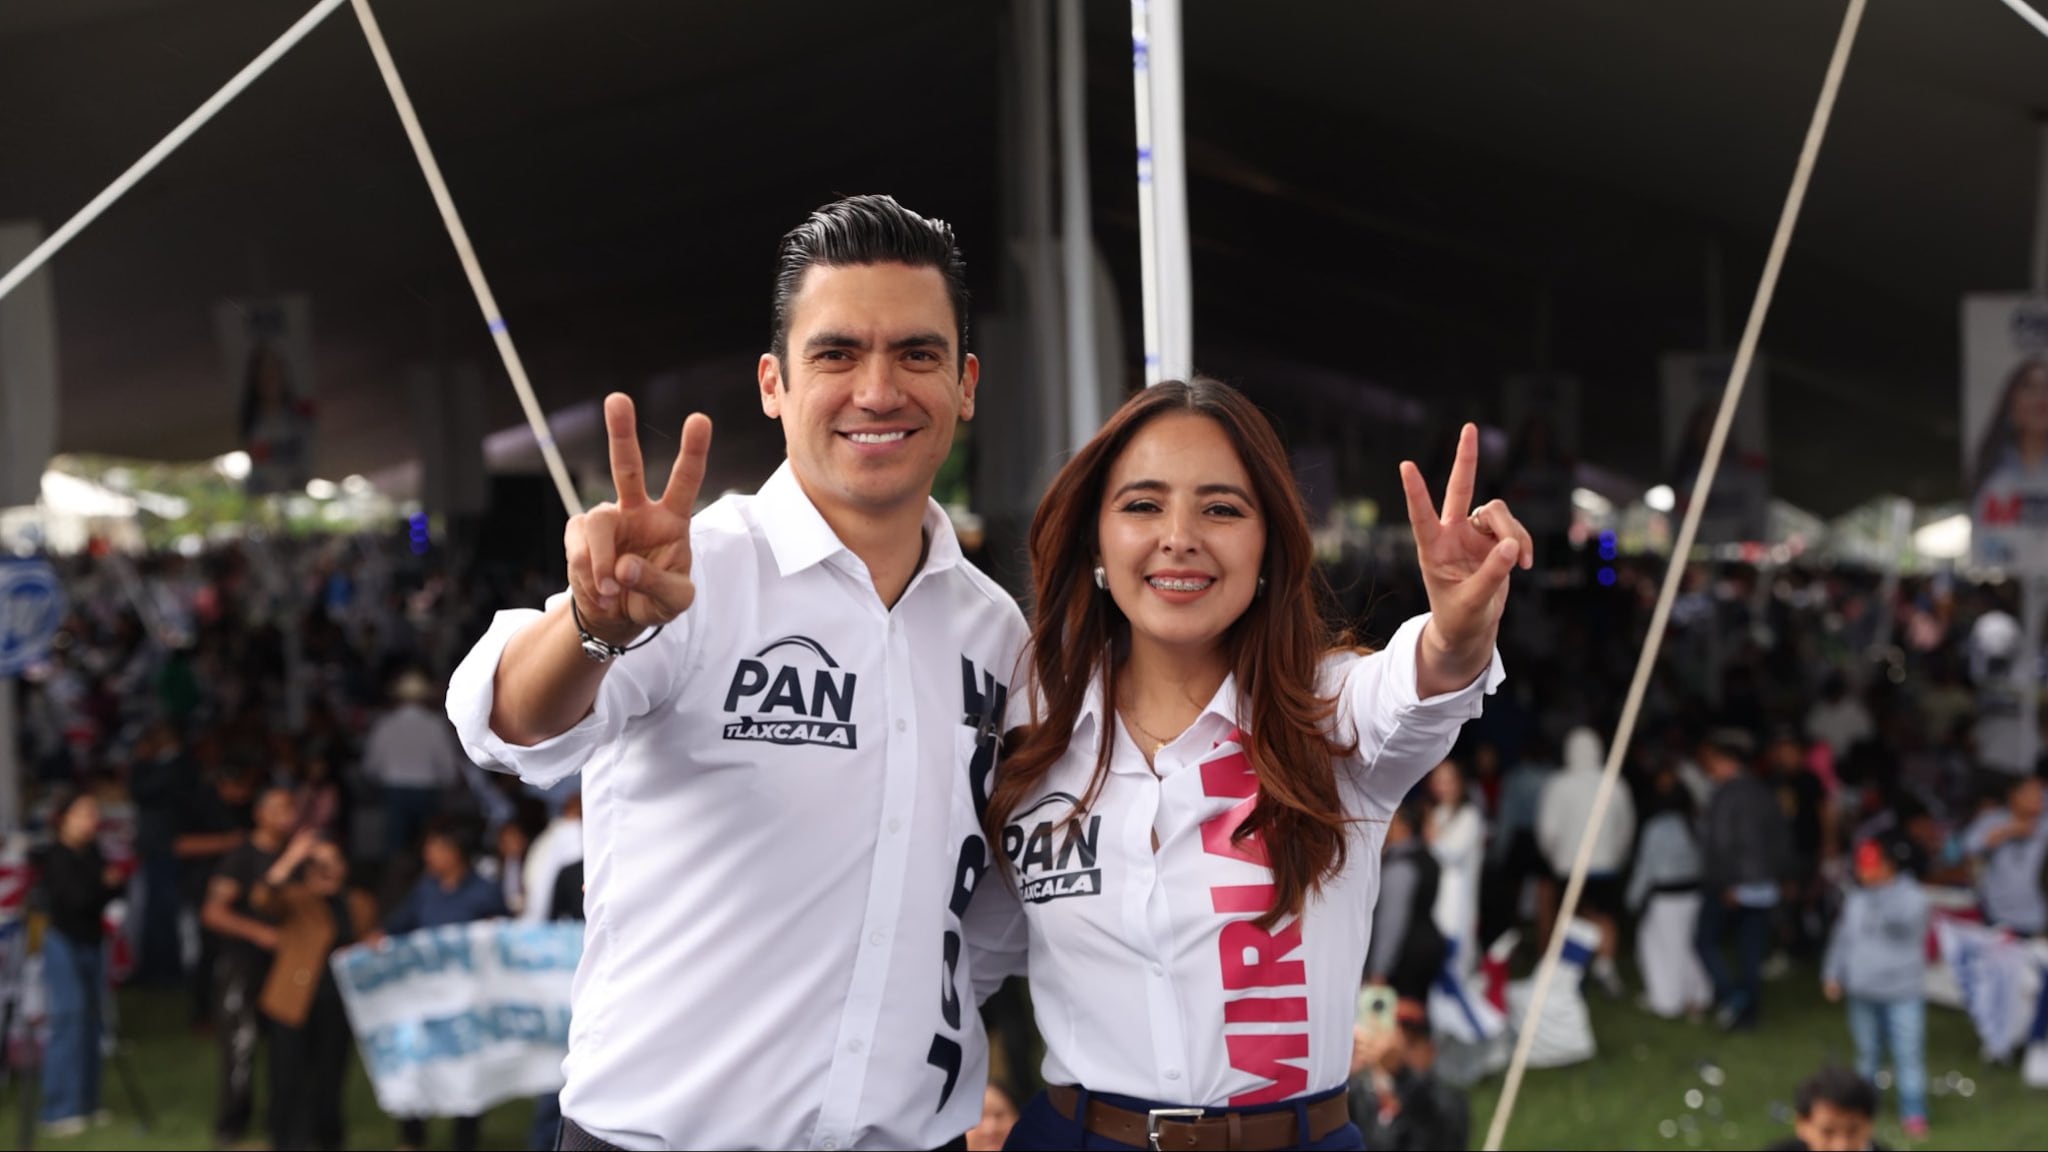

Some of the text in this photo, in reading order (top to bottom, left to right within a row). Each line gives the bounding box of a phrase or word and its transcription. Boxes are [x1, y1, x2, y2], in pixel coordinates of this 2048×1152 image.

[723, 658, 857, 723] PAN
[726, 722, 851, 747] TLAXCALA
[1001, 815, 1101, 875] PAN
